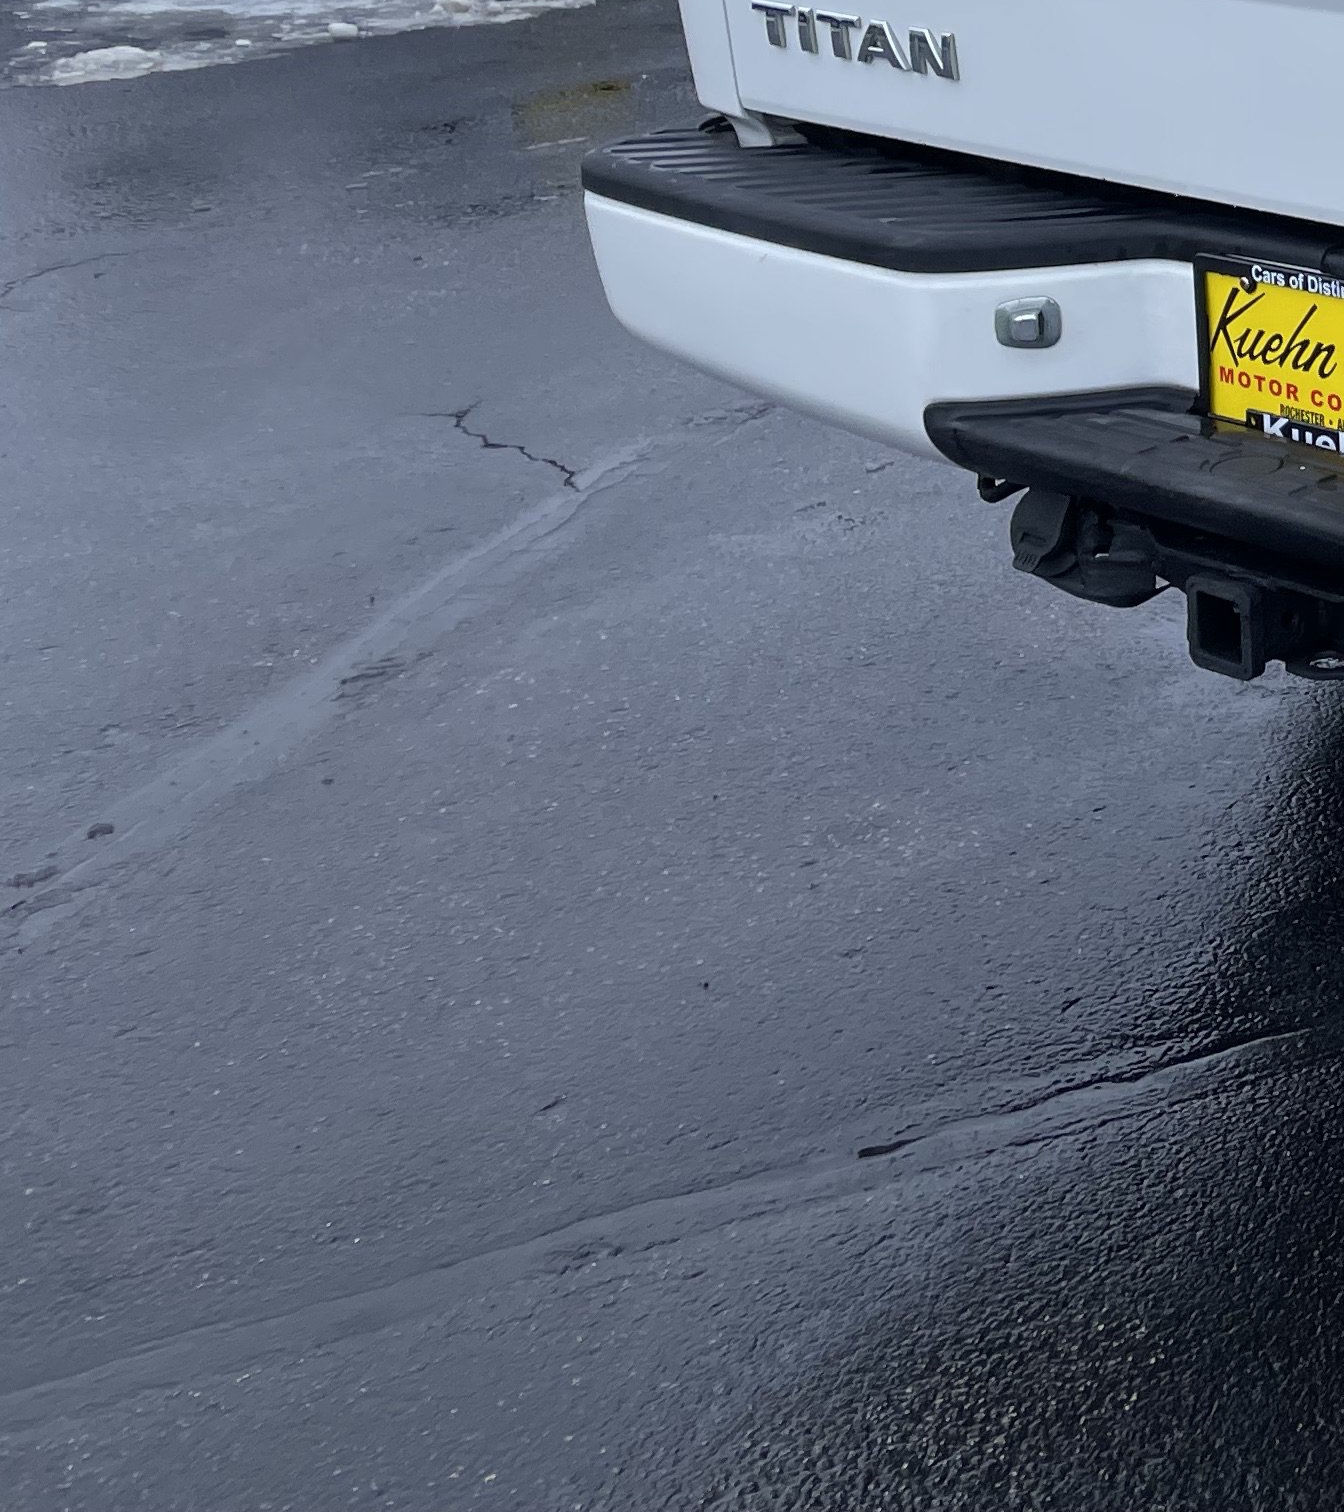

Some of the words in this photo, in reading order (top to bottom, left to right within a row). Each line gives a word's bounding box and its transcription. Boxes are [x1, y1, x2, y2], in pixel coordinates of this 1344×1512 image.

[1251, 264, 1285, 287] Cars
[1288, 274, 1305, 291] of
[1210, 287, 1338, 380] Kuehn
[1219, 365, 1300, 402] MOTOR
[1279, 403, 1326, 427] ROCHESTER
